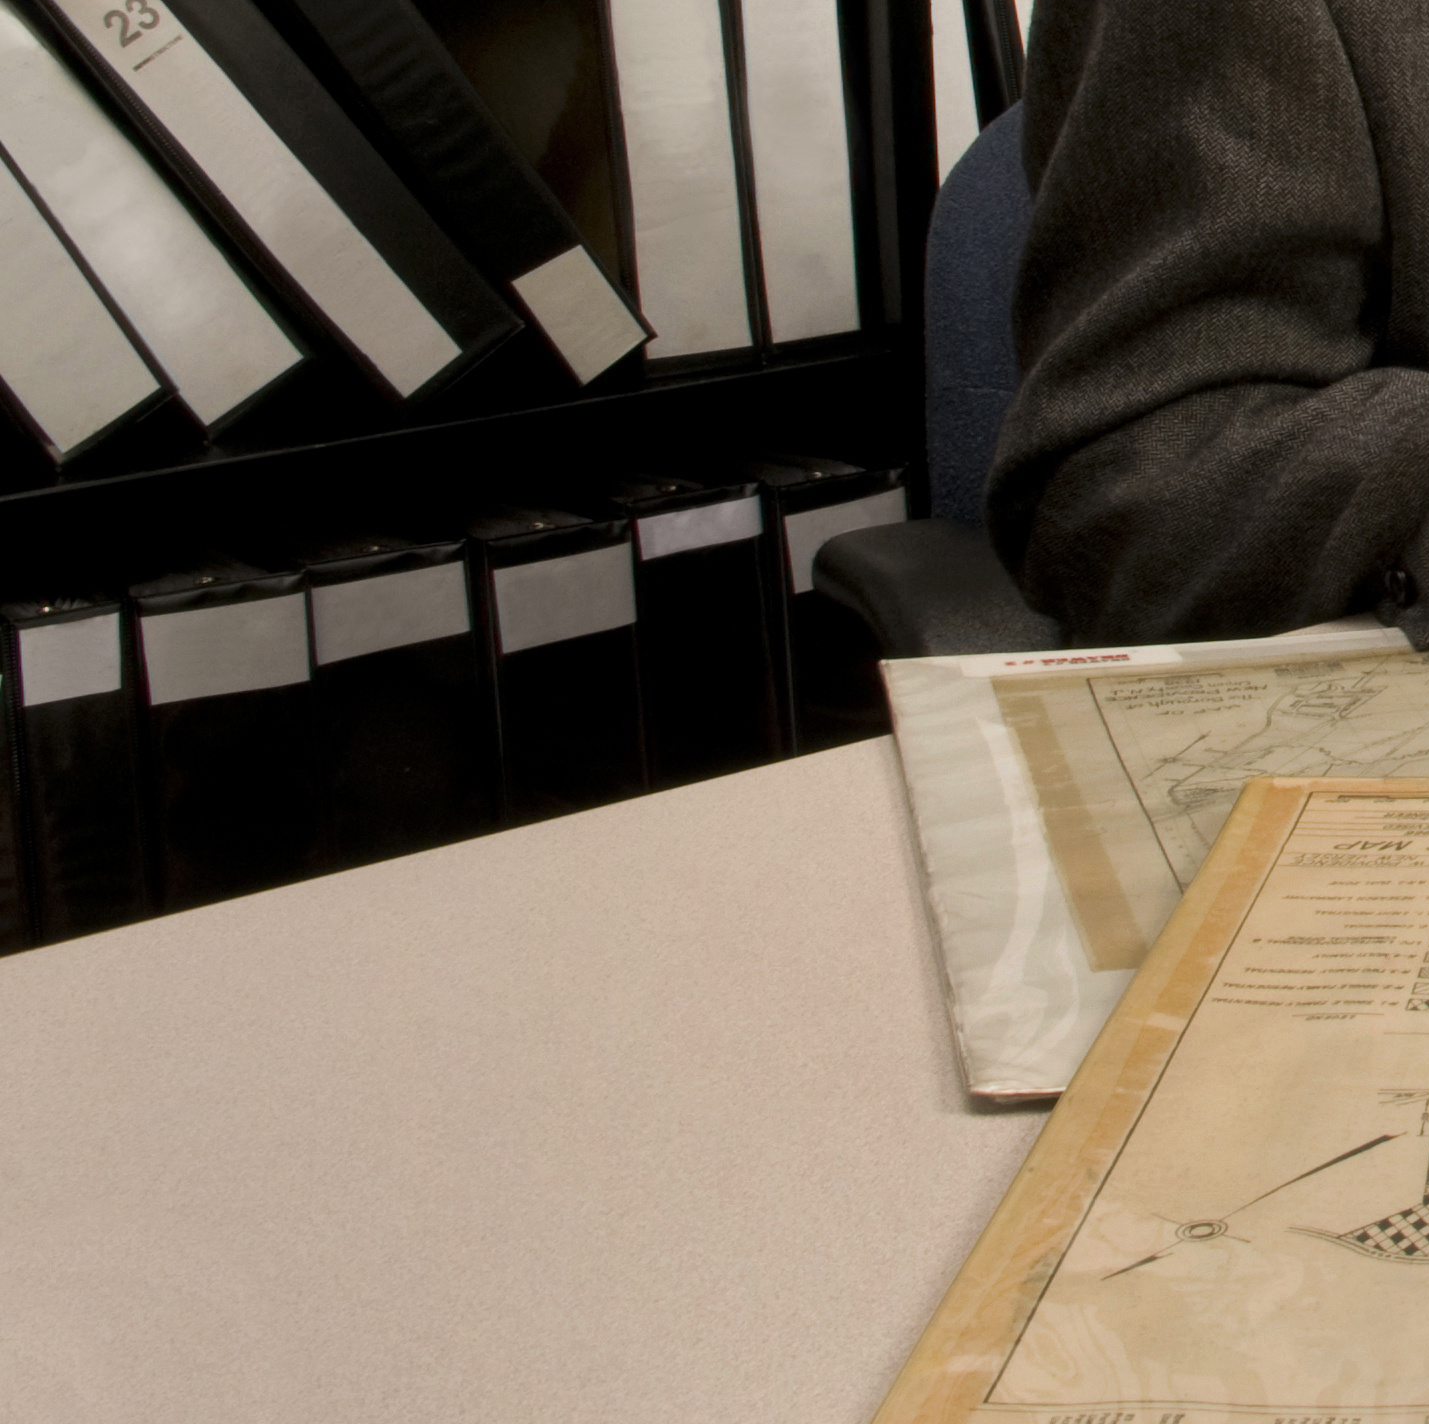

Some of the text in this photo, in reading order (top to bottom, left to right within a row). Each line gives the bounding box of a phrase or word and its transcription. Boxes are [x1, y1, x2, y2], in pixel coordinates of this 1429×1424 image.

[1333, 840, 1413, 852] MAP
[1291, 852, 1367, 861] JERSEY
[1376, 853, 1418, 861] NEW
[1288, 858, 1399, 867] PROVIDENCE
[1304, 1014, 1357, 1022] LEGEND
